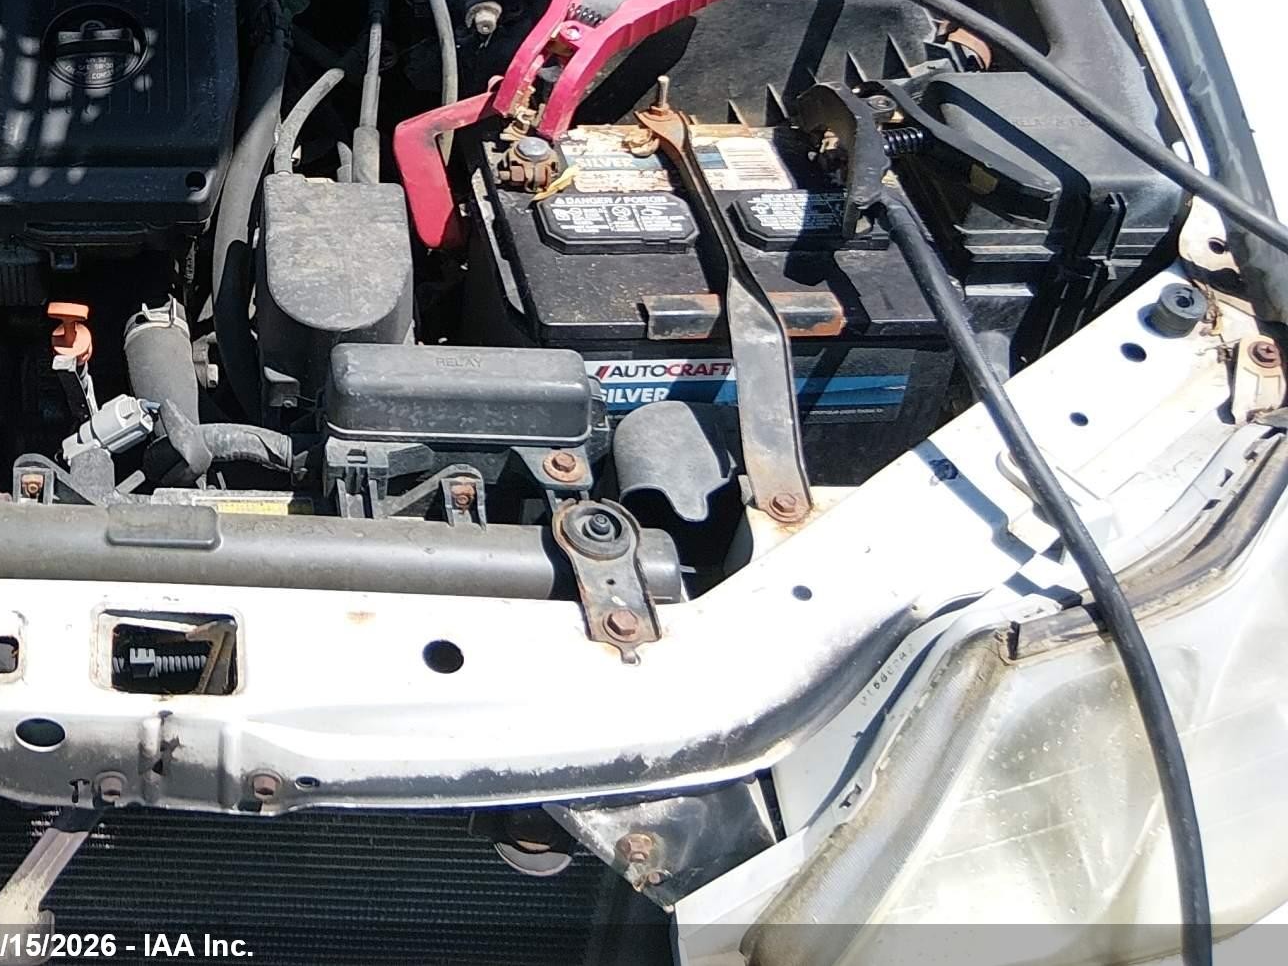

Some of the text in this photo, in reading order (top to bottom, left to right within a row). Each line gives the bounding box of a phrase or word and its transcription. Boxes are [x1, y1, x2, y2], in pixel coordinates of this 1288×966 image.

[435, 354, 482, 368] RELAY
[608, 362, 732, 379] AUTOCRAFT
[600, 387, 670, 403] SILVER
